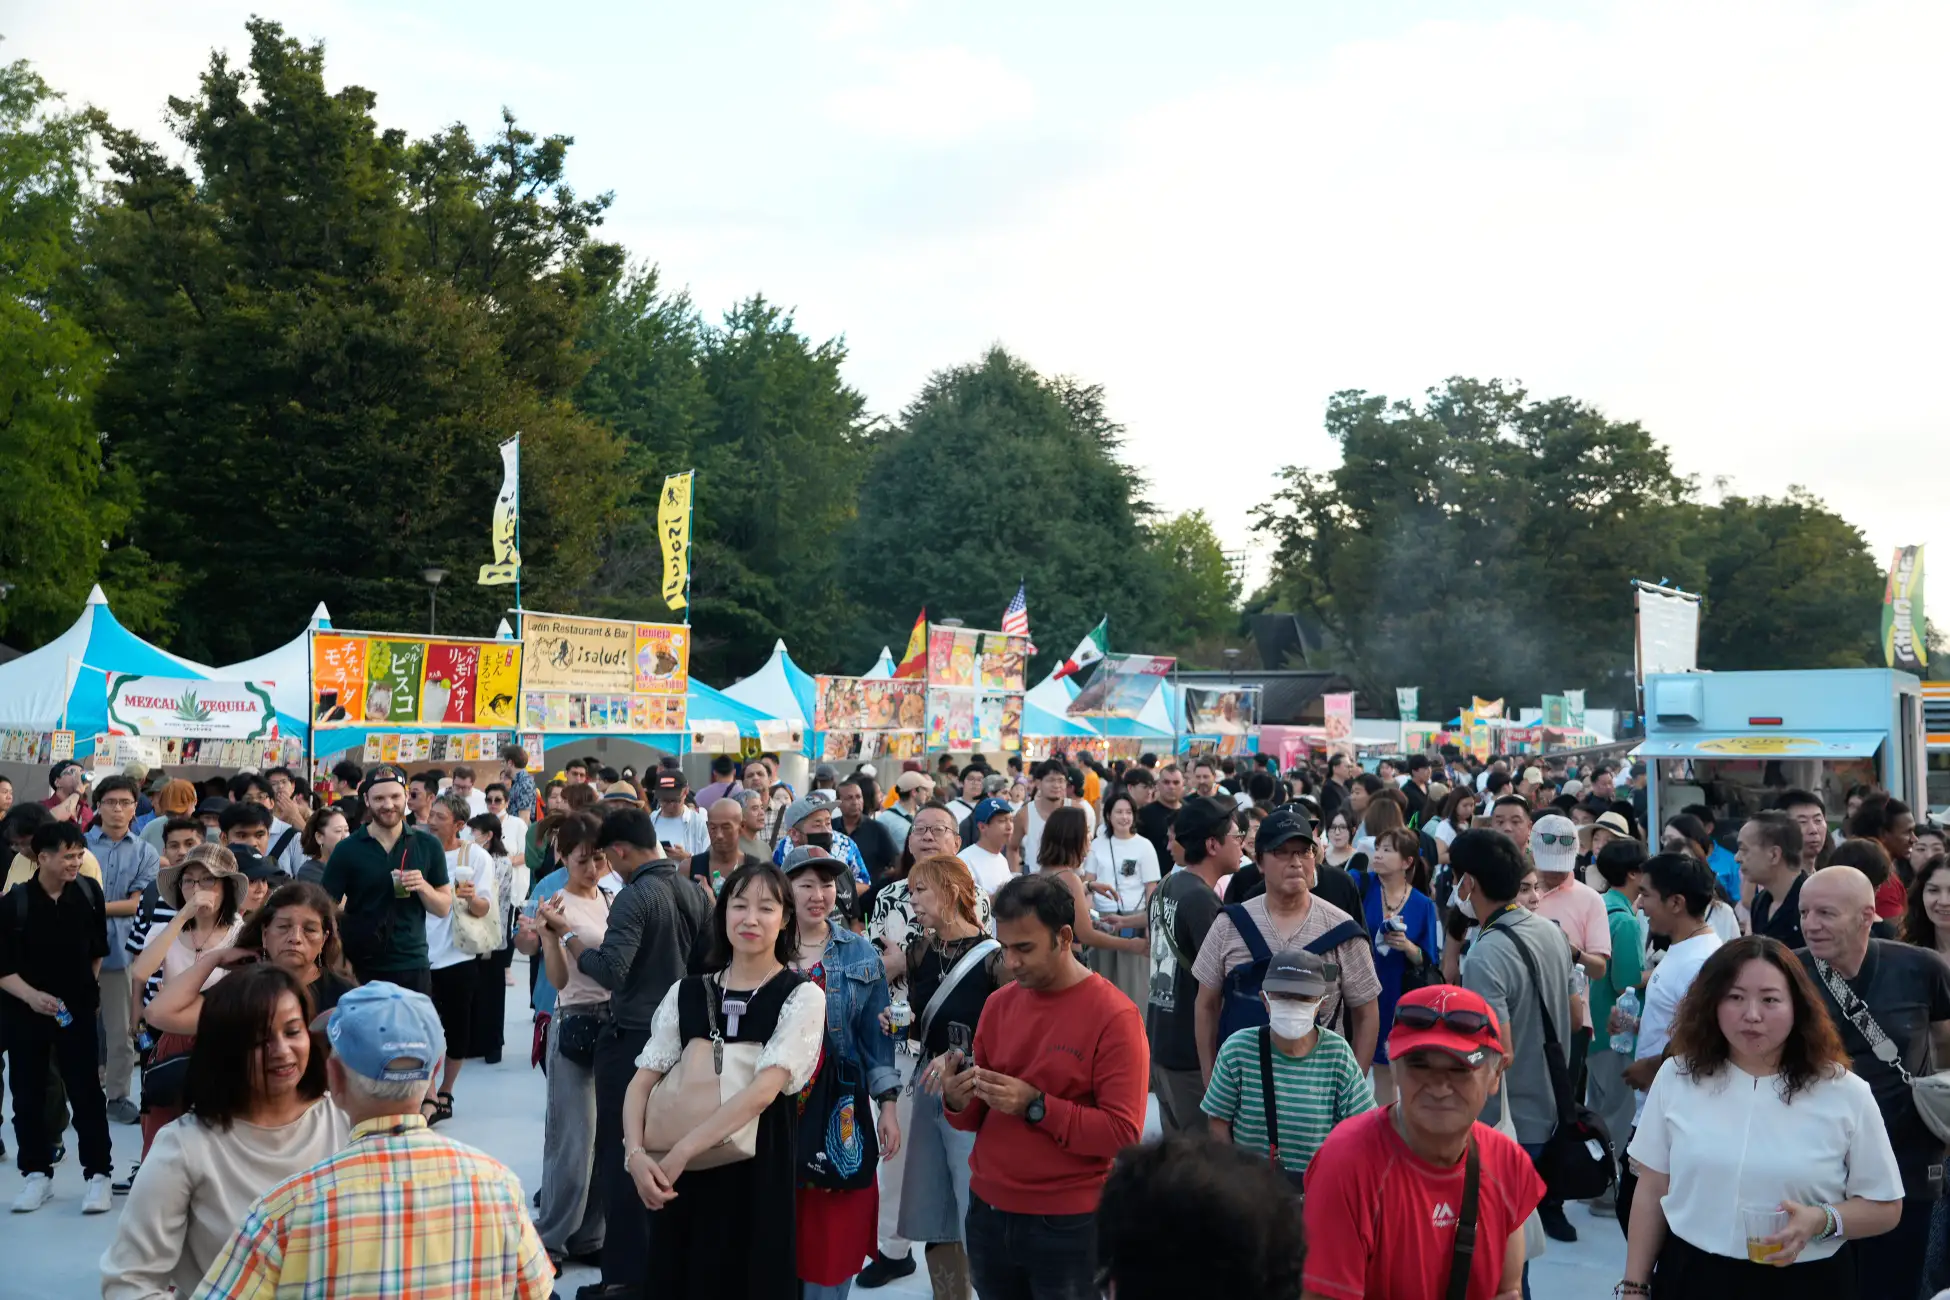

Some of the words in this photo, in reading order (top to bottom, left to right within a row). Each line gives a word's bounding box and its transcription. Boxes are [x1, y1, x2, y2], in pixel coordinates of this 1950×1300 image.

[527, 620, 550, 632] Latin
[552, 623, 602, 637] Restaurant
[604, 628, 611, 637] &
[614, 628, 629, 638] Bar
[391, 653, 415, 714] ピスコ
[124, 694, 180, 710] MEZCAL
[199, 699, 258, 713] TEQUILA
